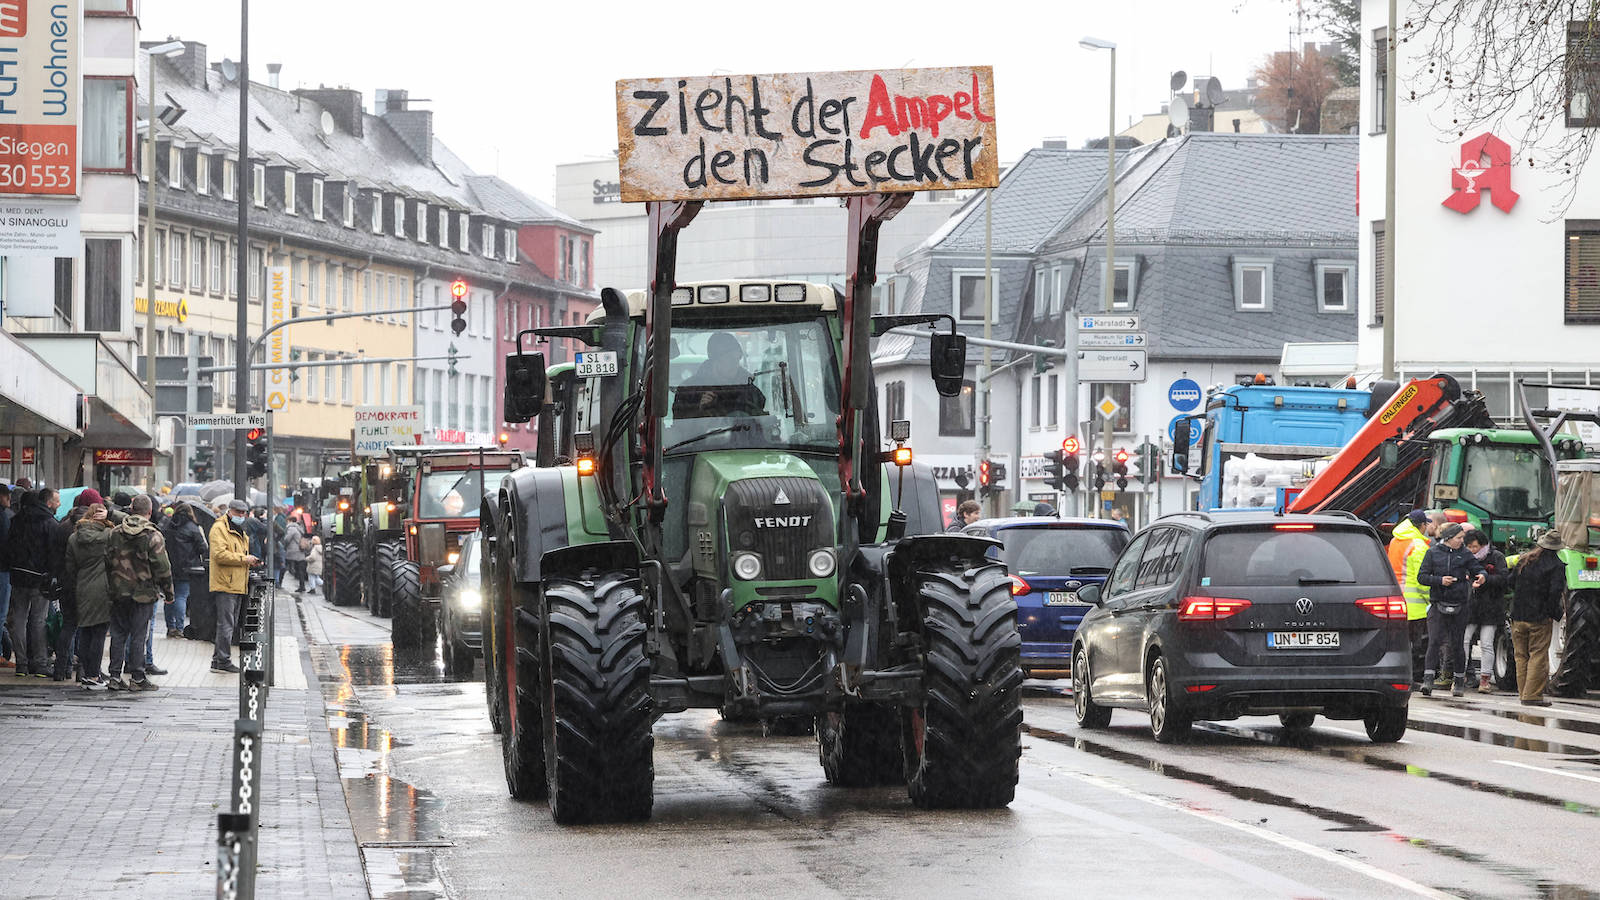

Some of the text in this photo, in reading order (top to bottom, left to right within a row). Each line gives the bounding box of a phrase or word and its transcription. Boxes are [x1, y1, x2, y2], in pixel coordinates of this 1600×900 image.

[42, 4, 68, 116] Wohnen
[792, 78, 856, 138] der
[860, 73, 995, 139] Ampel
[0, 136, 69, 160] Siegen
[683, 132, 983, 189] den Stecker
[8, 218, 69, 228] SINANOGLU
[595, 363, 615, 373] 818
[1382, 386, 1417, 422] PALFINGER
[188, 415, 265, 426] Hammerhütter Weg
[355, 411, 419, 422] DEMOKRATIE
[754, 515, 812, 529] FENDT
[1049, 593, 1063, 603] OD
[1274, 633, 1339, 645] UN UF 854
